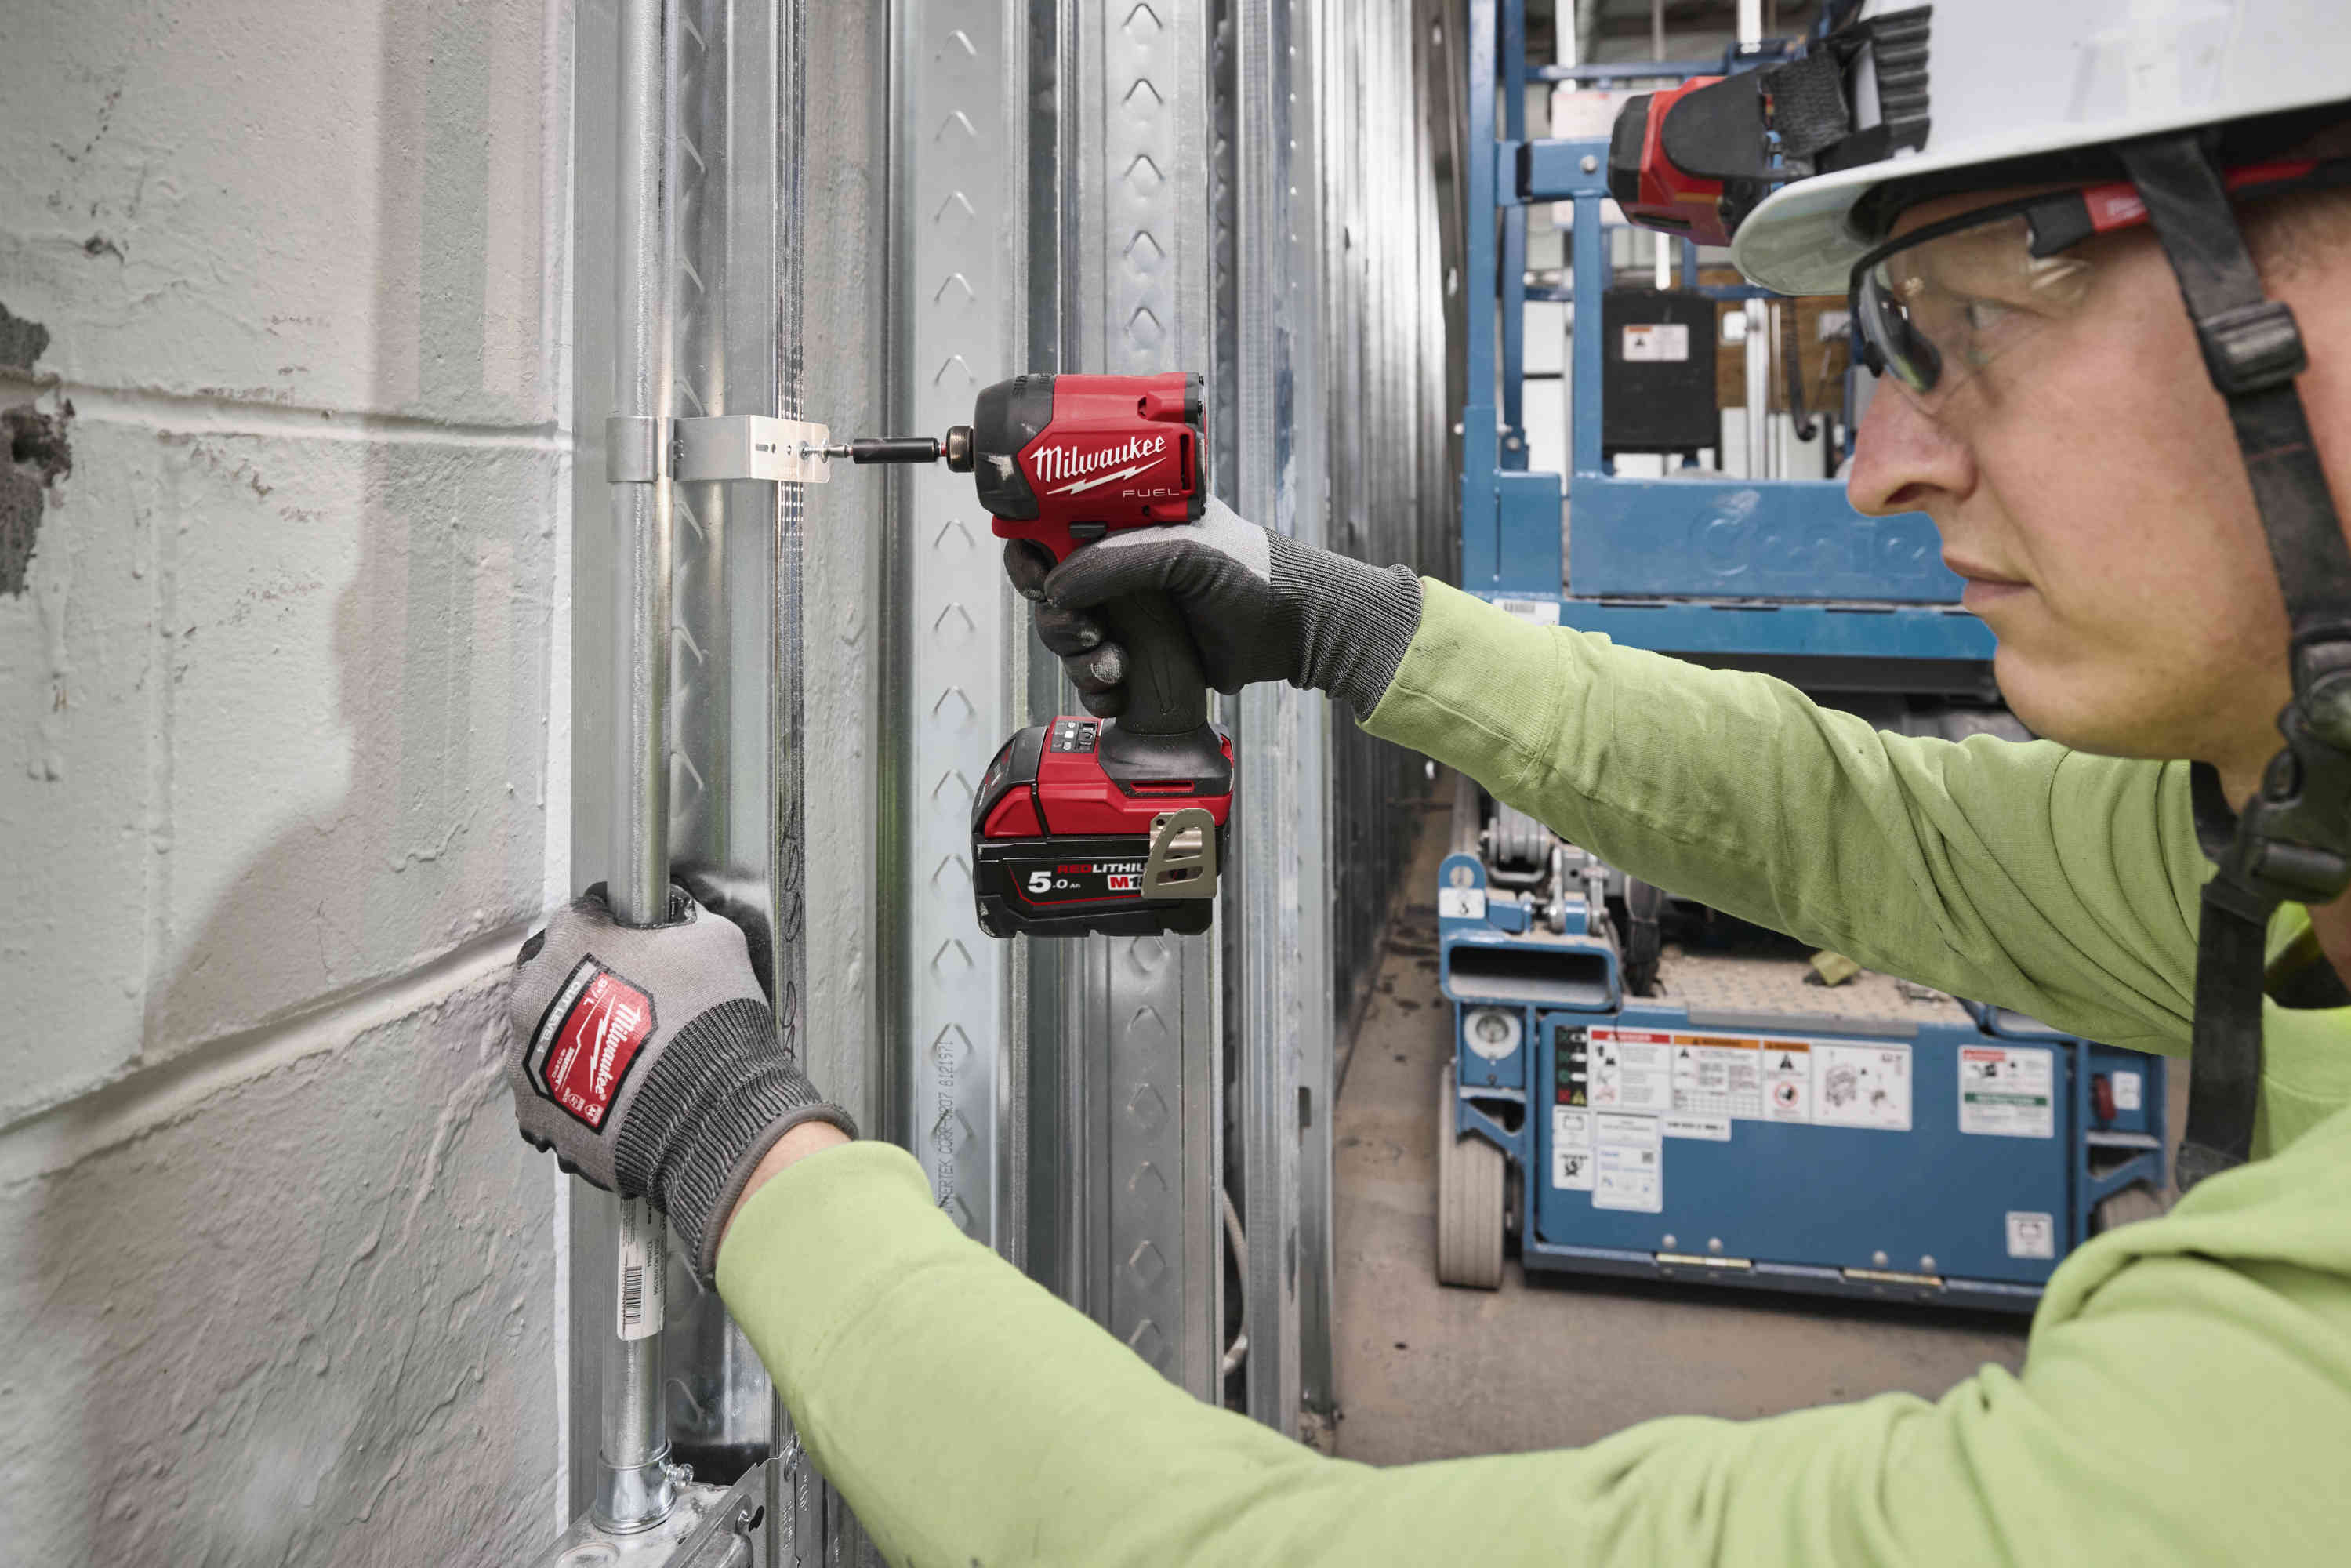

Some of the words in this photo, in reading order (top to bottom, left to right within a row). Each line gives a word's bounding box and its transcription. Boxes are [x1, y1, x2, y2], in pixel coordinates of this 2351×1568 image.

[1029, 435, 1167, 483] Milwaukee
[1123, 488, 1180, 498] FUEL
[1056, 863, 1146, 874] REDLITHIU
[1028, 871, 1068, 894] 5.0
[561, 981, 581, 1005] CUT
[540, 1007, 564, 1043] LEVEL
[536, 1044, 546, 1054] 4
[595, 1003, 641, 1094] Milwaukee
